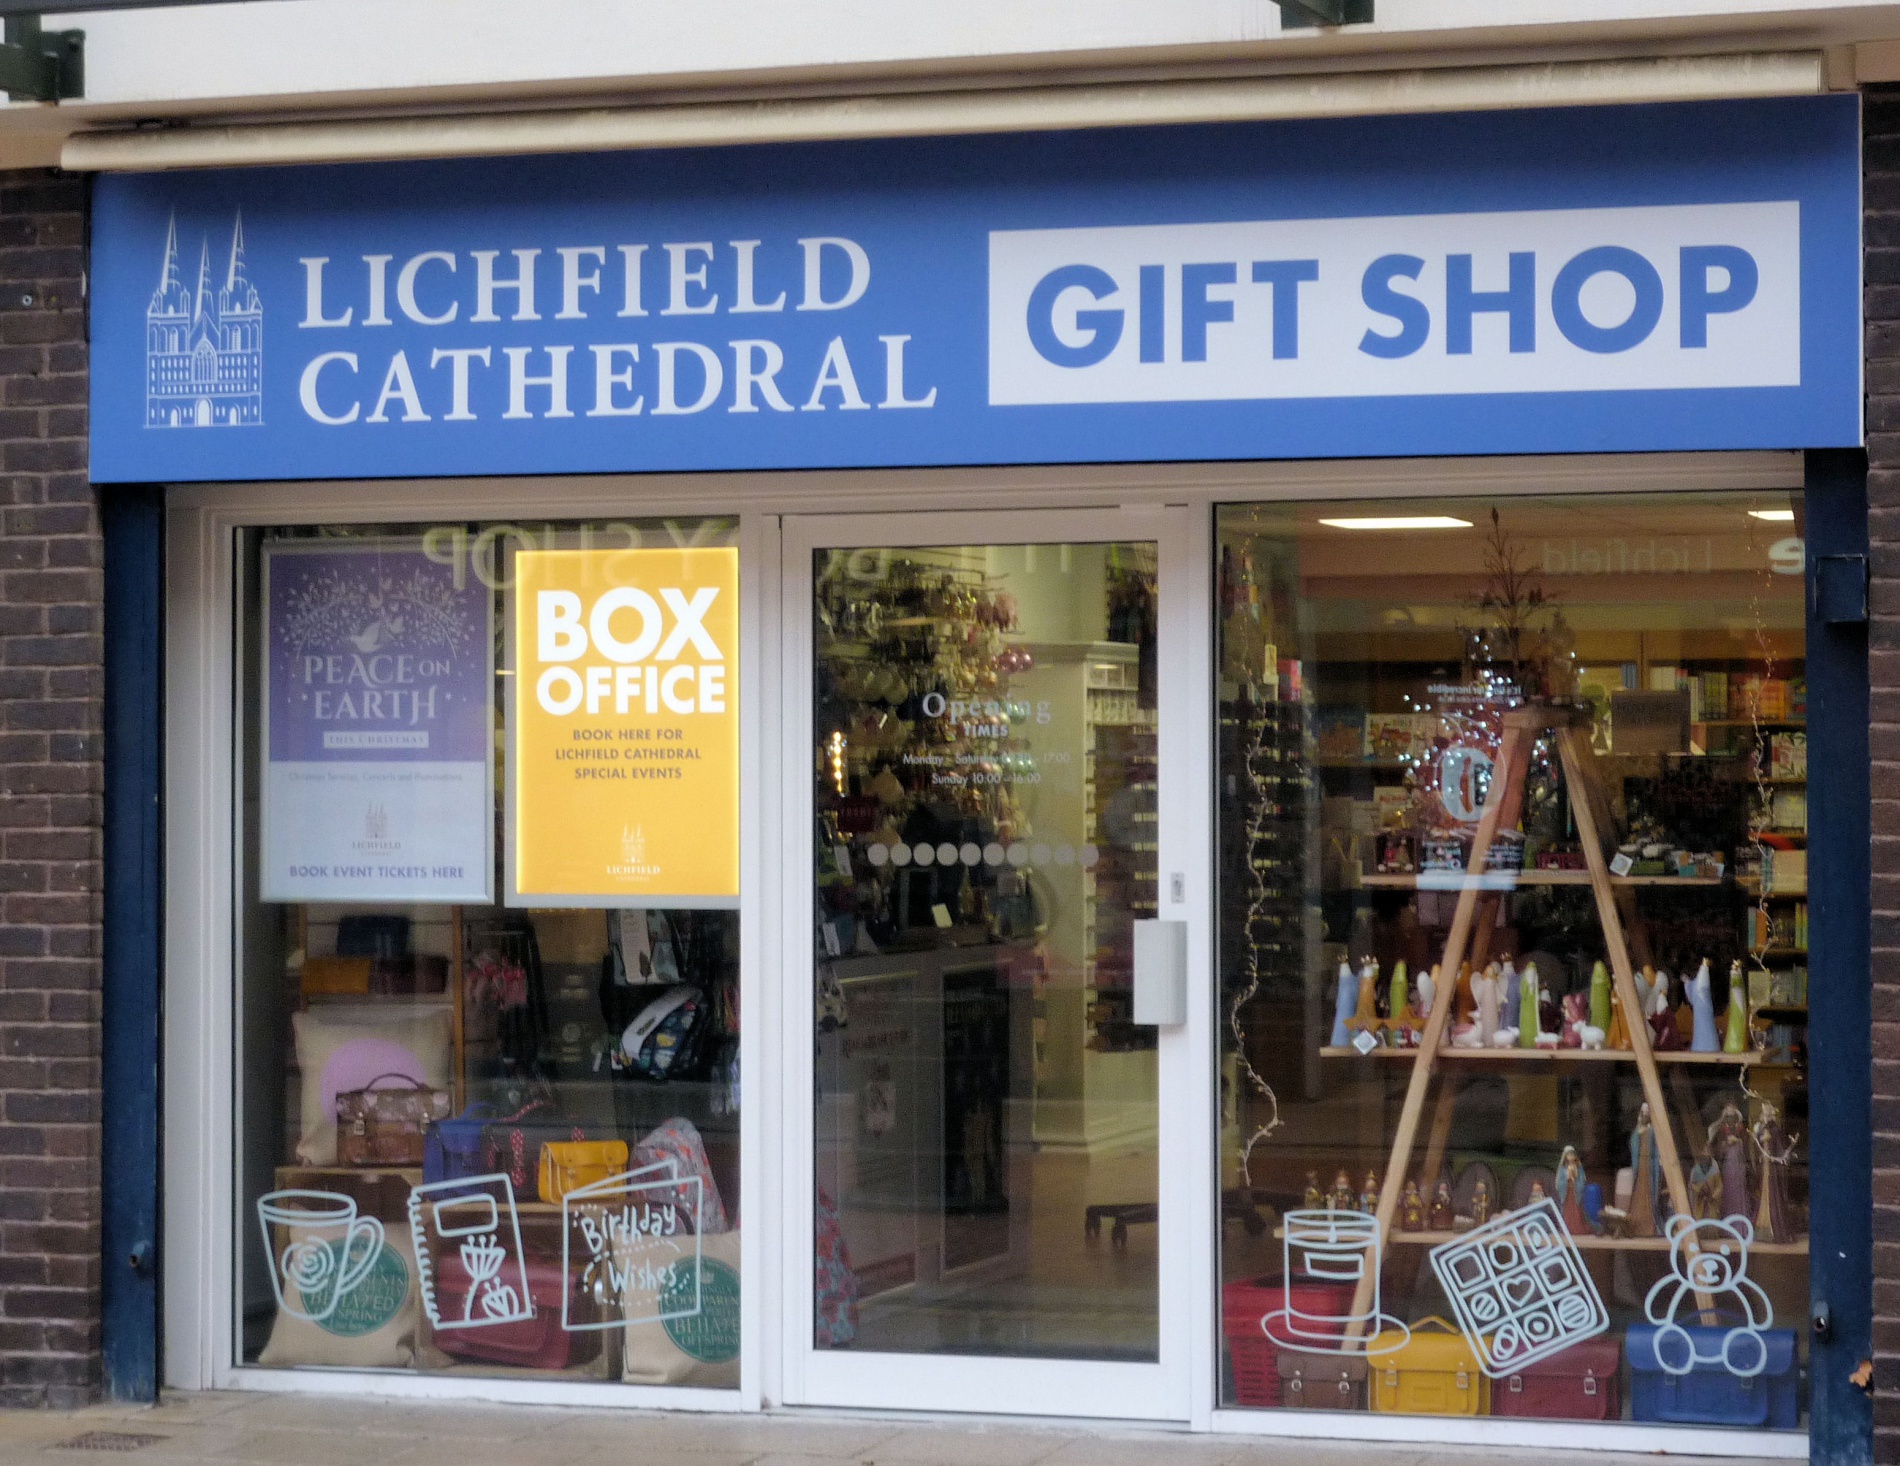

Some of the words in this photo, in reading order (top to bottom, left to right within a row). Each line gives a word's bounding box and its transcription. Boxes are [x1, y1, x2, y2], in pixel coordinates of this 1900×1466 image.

[298, 236, 871, 329] LICHFIELD
[1026, 258, 1320, 369] GIFT
[1357, 245, 1759, 360] SHOP
[298, 333, 938, 426] CATHEDRAL
[537, 586, 725, 664] BOX
[303, 654, 414, 689] PEACE
[418, 659, 450, 677] ON
[315, 684, 438, 726] EARTH
[536, 664, 726, 716] OFFICE
[922, 692, 1051, 725] Opening
[572, 729, 613, 741] BOOK
[618, 729, 652, 740] HERE
[656, 728, 684, 740] FOR
[963, 724, 1009, 737] TIMES
[555, 748, 620, 760] LICHFIELD
[623, 747, 702, 760] CATHEDRAL
[903, 754, 944, 767] Monday
[574, 767, 627, 779] SPECIAL
[632, 767, 682, 779] EVENTS
[932, 773, 968, 786] Sunday
[972, 773, 1000, 784] 10:00
[289, 866, 328, 878] BOOK
[333, 866, 374, 878] EVENT
[378, 866, 428, 878] TICKETS
[432, 866, 465, 879] HERE
[606, 864, 661, 875] LICHFIELD
[581, 1202, 677, 1254] Birthday
[607, 1257, 677, 1294] Wishes
